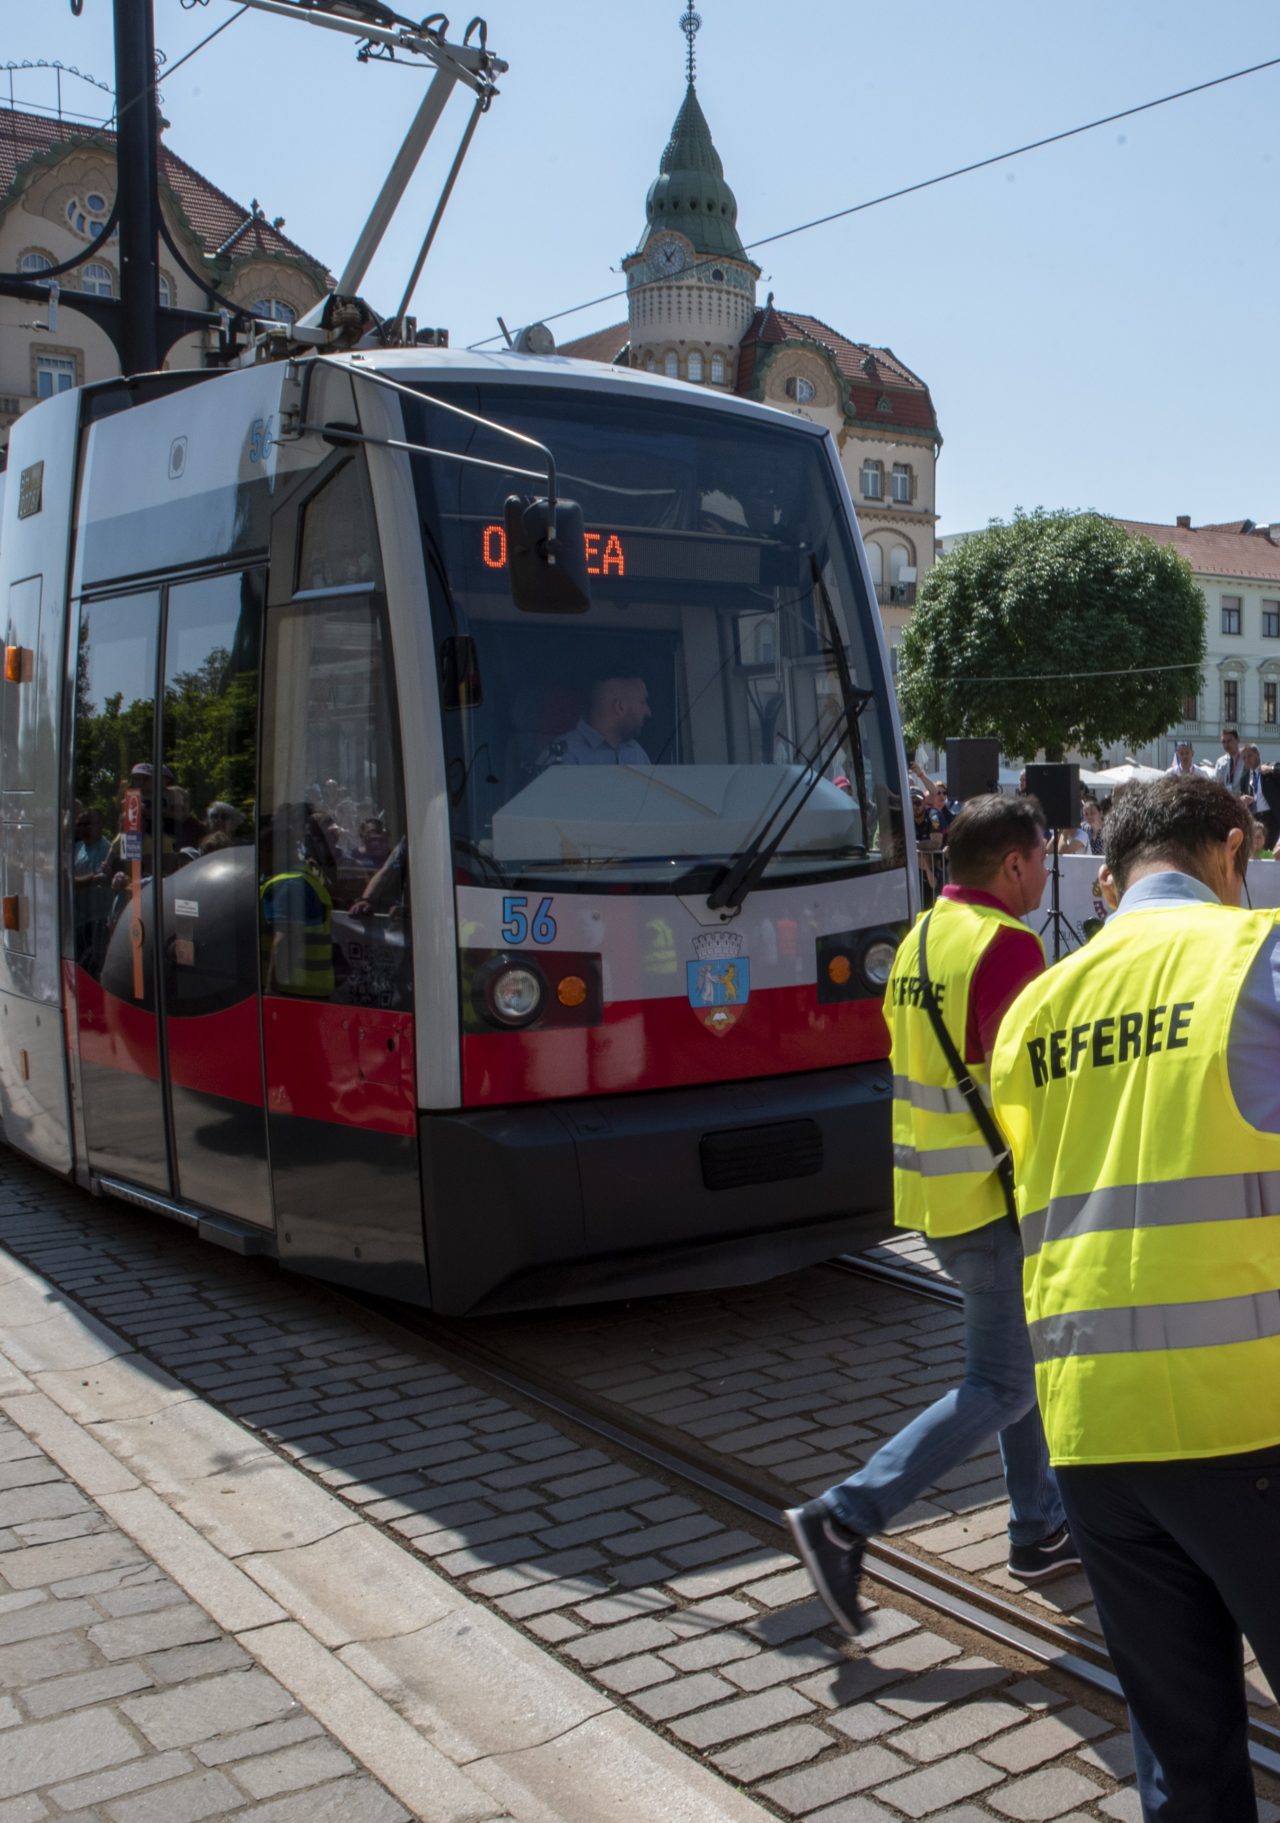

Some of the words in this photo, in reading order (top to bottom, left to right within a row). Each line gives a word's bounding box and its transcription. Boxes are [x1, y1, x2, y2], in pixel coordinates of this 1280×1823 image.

[250, 416, 273, 463] 56
[501, 896, 558, 945] 56
[1026, 1001, 1195, 1088] REFEREE
